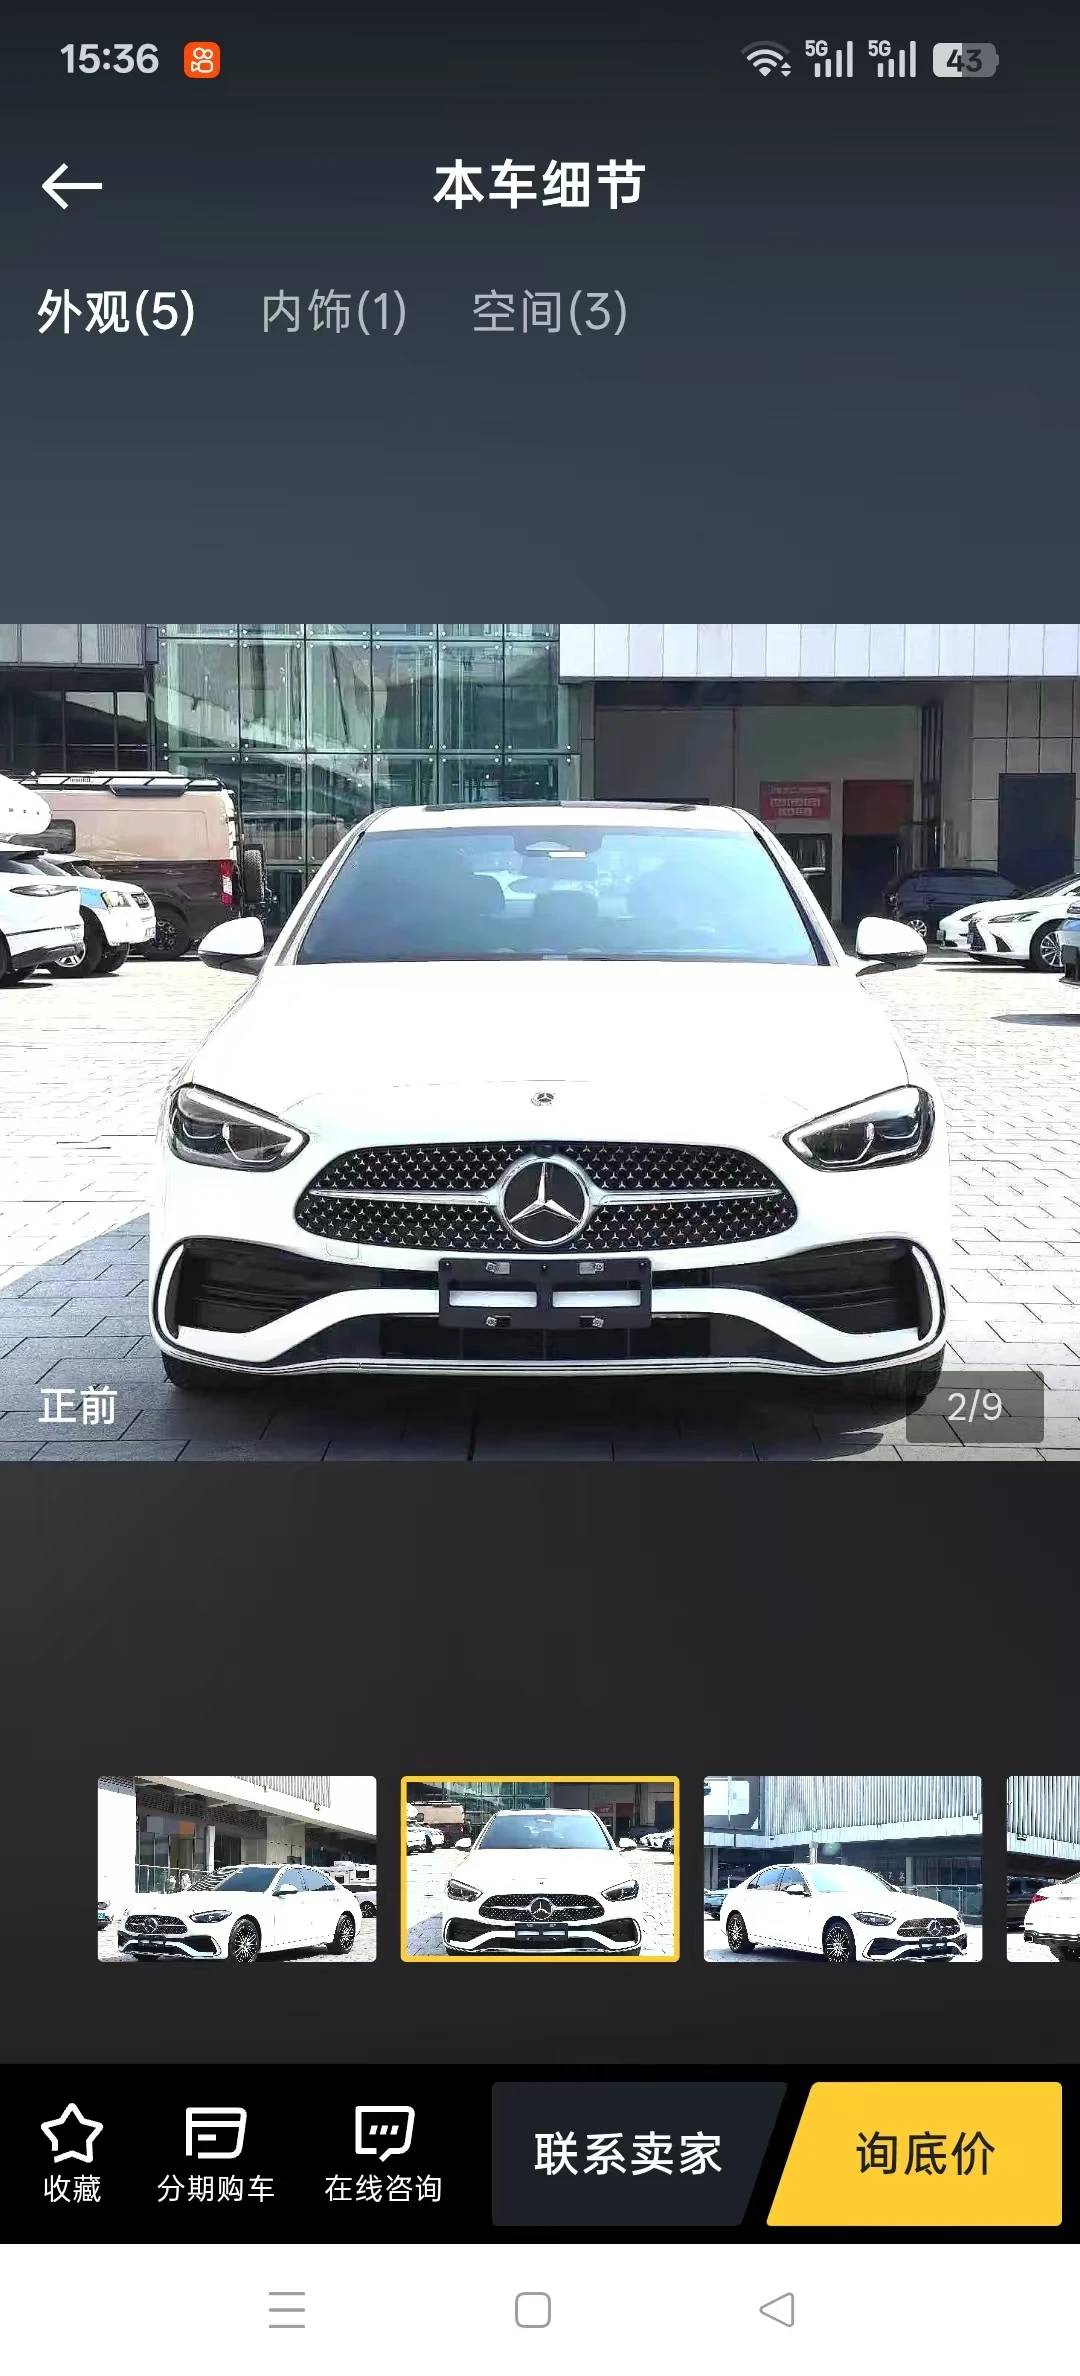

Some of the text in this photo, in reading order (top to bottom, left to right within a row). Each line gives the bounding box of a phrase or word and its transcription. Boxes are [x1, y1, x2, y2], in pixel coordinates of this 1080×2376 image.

[60, 42, 160, 74] 15:36
[805, 40, 828, 57] 5G
[868, 40, 891, 57] 5G
[946, 49, 983, 73] 43
[433, 157, 646, 210] 本车细节
[37, 288, 195, 337] 外观(5)
[261, 288, 406, 336] 内饰(1)
[472, 288, 627, 336] 空间(3)
[533, 2130, 723, 2176] 联系卖家
[855, 2129, 996, 2177] 询底价
[43, 2173, 102, 2204] 收藏
[156, 2173, 275, 2203] 分期购车
[324, 2173, 442, 2203] 在线咨询
